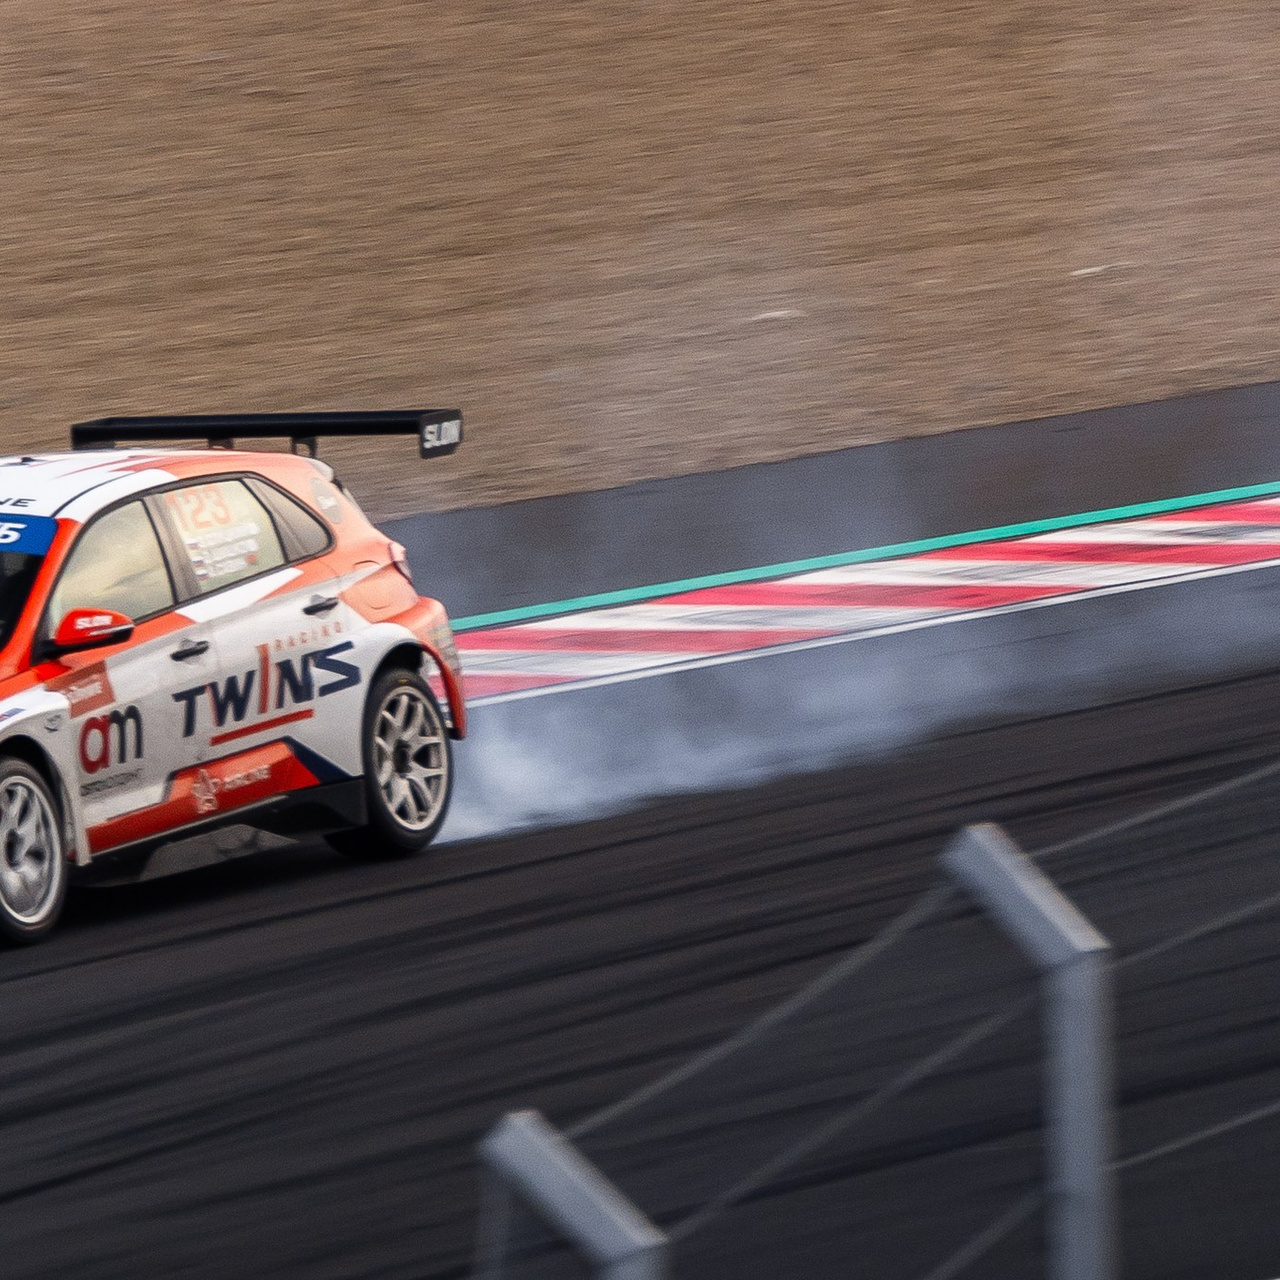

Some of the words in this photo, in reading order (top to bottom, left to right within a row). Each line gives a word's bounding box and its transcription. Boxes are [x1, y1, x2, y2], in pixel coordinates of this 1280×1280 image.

[164, 484, 233, 532] 123
[171, 640, 363, 738] TWINS
[78, 704, 145, 774] am
